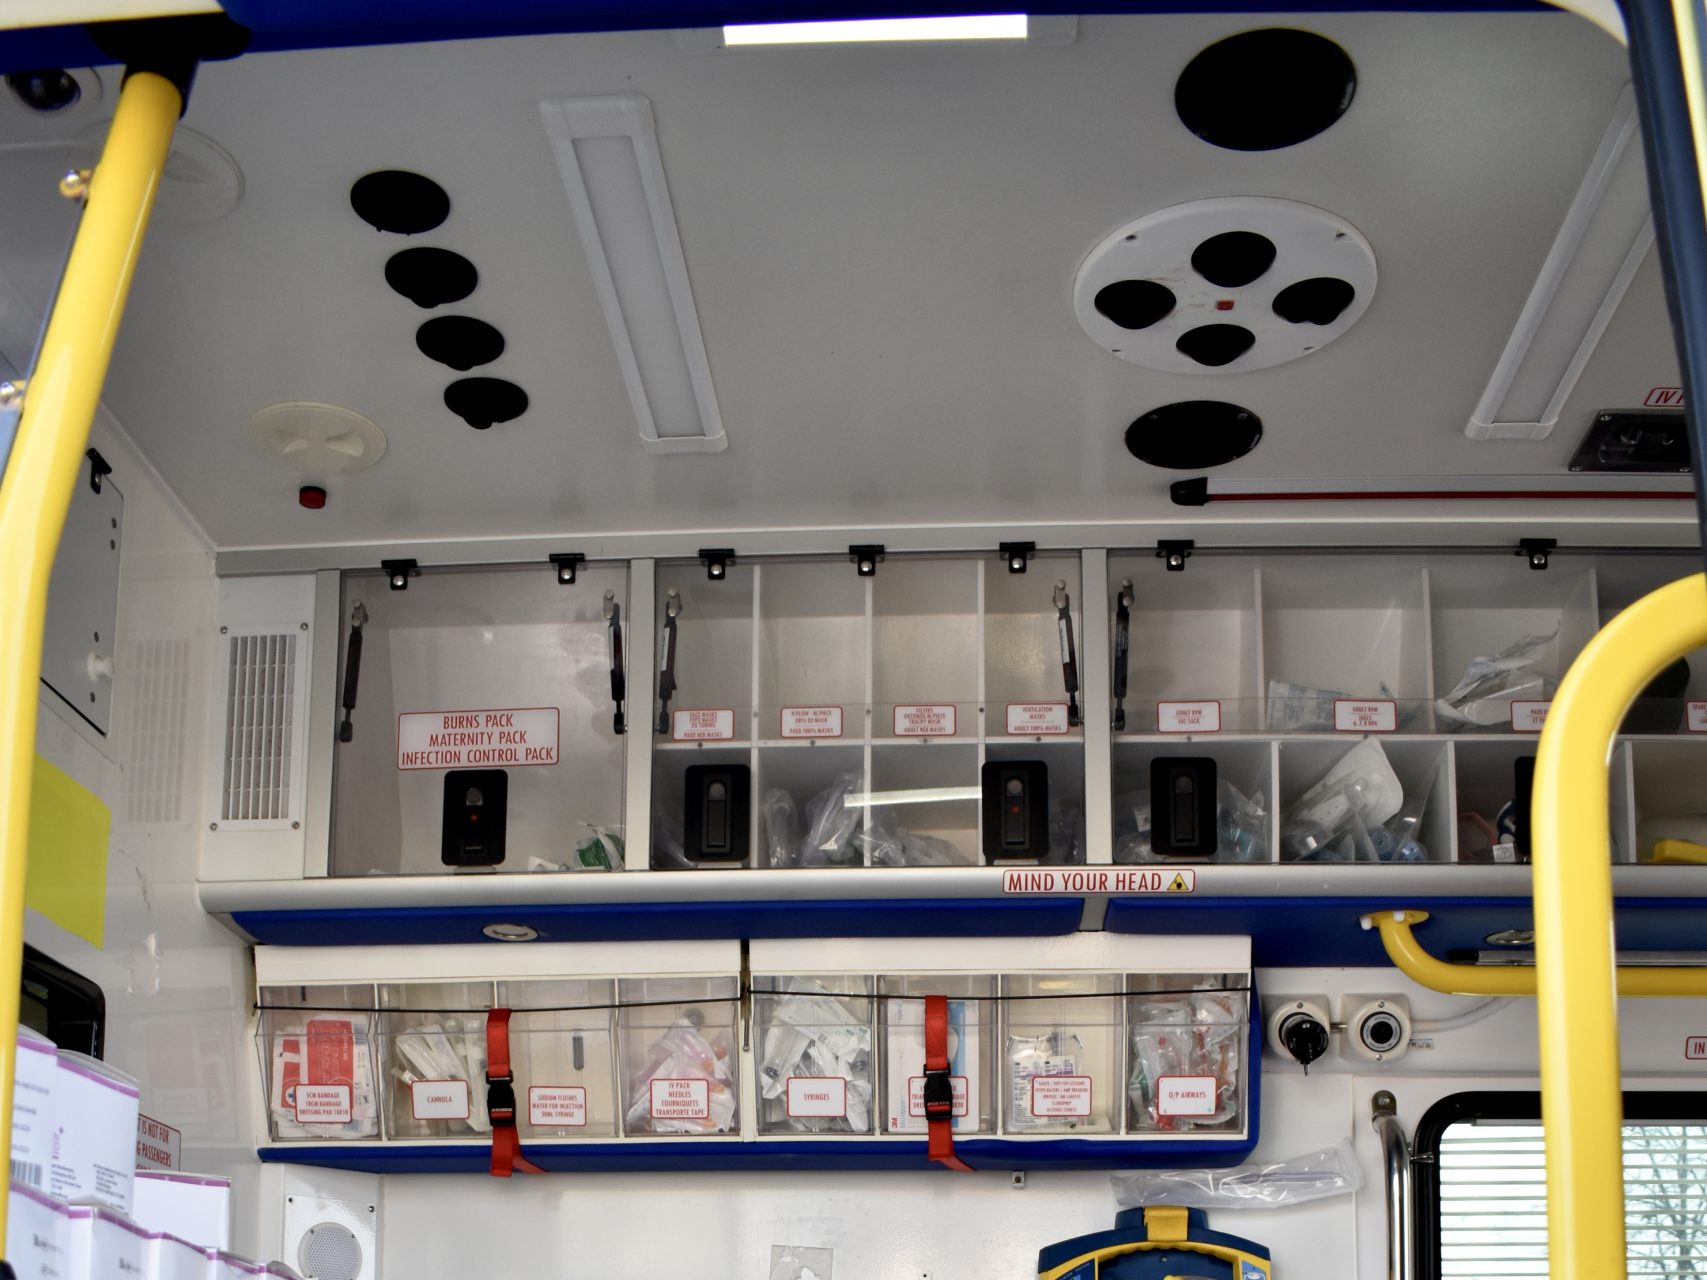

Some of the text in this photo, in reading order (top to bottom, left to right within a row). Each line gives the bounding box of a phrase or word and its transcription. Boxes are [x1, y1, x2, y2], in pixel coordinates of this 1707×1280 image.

[1655, 390, 1678, 404] IV
[444, 714, 514, 729] BURNS PACK
[429, 730, 527, 747] MATERNITY PACK
[402, 747, 553, 765] INFECTION CONTROL PACK
[1008, 873, 1162, 891] MIND YOUR HEAD
[142, 1120, 147, 1134] IS
[148, 1122, 158, 1140] NOT
[160, 1127, 169, 1144] FOR
[142, 1142, 171, 1168] PASSENGERS
